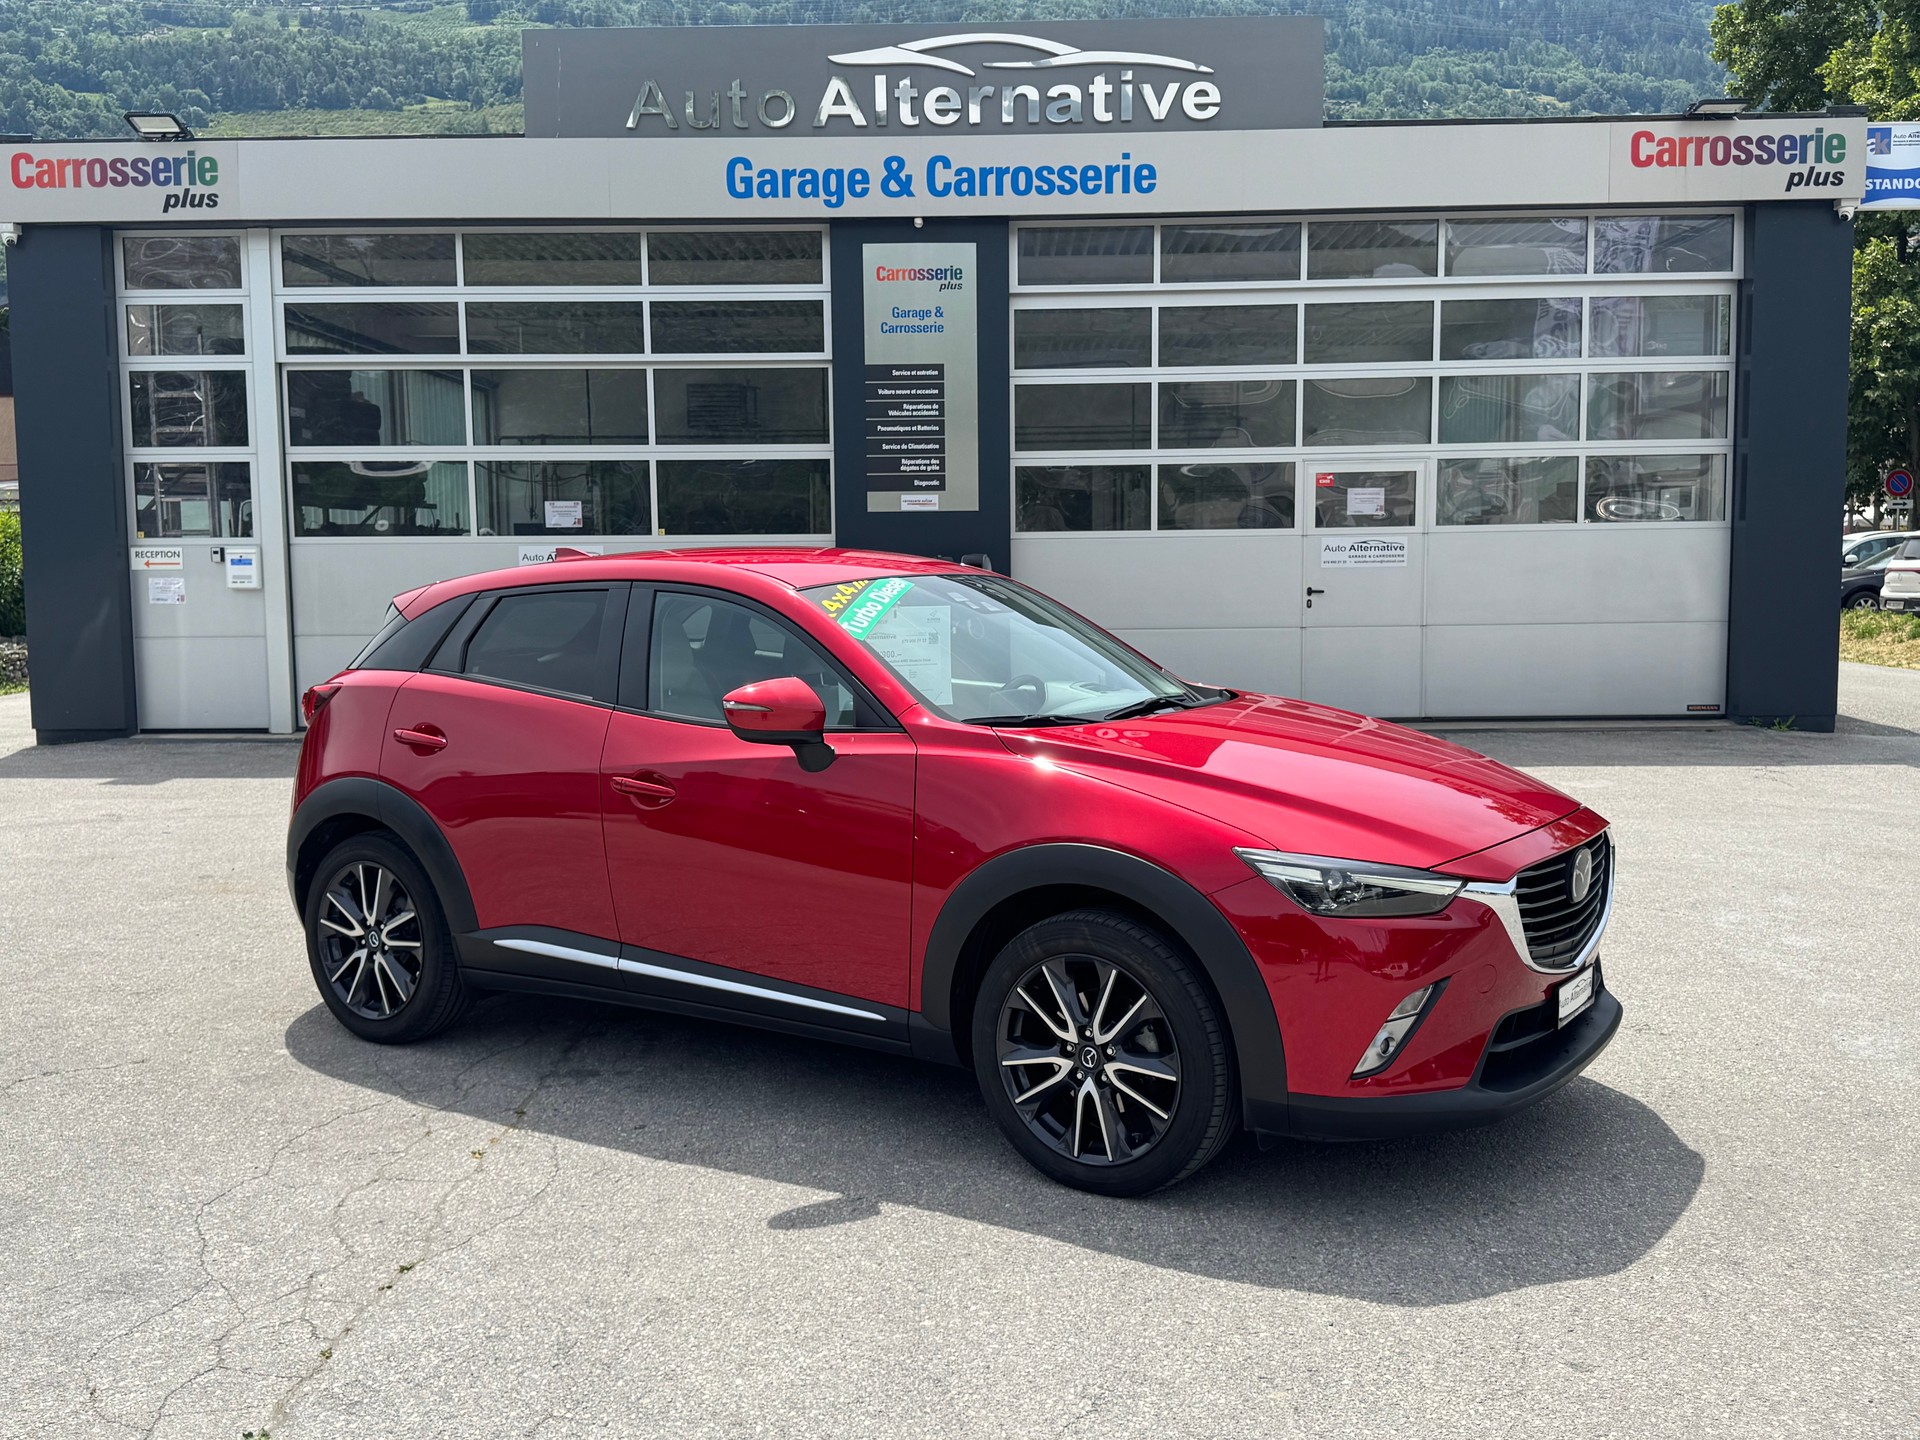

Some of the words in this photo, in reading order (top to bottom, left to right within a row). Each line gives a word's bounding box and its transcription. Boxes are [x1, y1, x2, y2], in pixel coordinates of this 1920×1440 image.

[625, 78, 796, 130] Auto
[811, 70, 1222, 127] Alternative
[1630, 128, 1846, 168] Carrosserie
[10, 150, 219, 189] Carrosserie
[726, 156, 870, 209] Garage
[880, 155, 914, 199] &
[926, 153, 1158, 198] Carrosserie
[1785, 166, 1845, 192] plus
[162, 188, 219, 213] plus
[876, 265, 963, 281] Carrosserie
[939, 281, 963, 292] plus
[892, 306, 932, 320] Garage
[934, 306, 944, 318] &
[880, 321, 945, 334] Carrosserie
[914, 479, 940, 487] Diagnostic
[135, 550, 181, 559] RECEPTION
[1323, 544, 1347, 552] Auto
[1348, 543, 1405, 552] Alternative
[522, 553, 544, 562] Auto
[841, 601, 883, 633] Turbo
